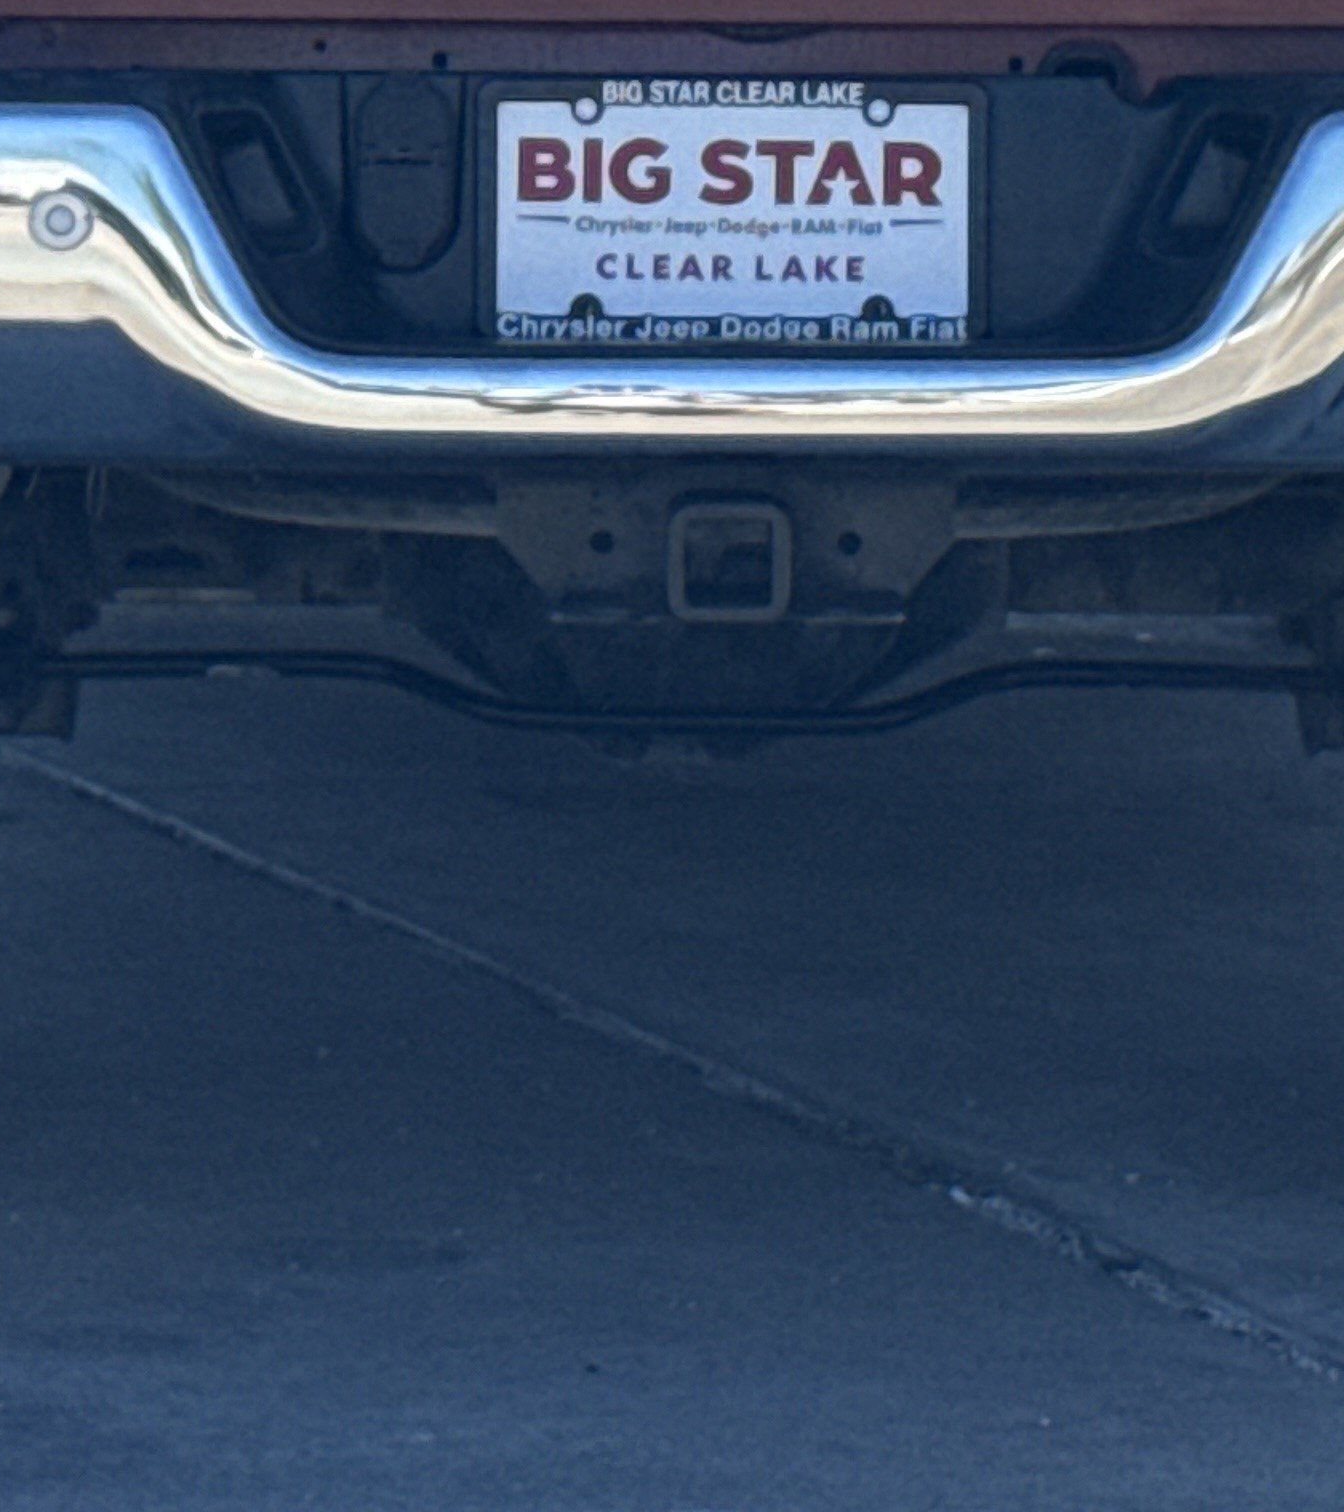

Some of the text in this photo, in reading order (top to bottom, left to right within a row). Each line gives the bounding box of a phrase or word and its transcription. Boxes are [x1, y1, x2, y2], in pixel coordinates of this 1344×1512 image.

[602, 80, 866, 105] BIG STAR CLEAR LAKE
[517, 137, 943, 206] BIG STAR
[596, 253, 865, 283] CLEAR LAKE
[496, 312, 968, 340] Chrysler Jeep Dodge Ram Fiat
